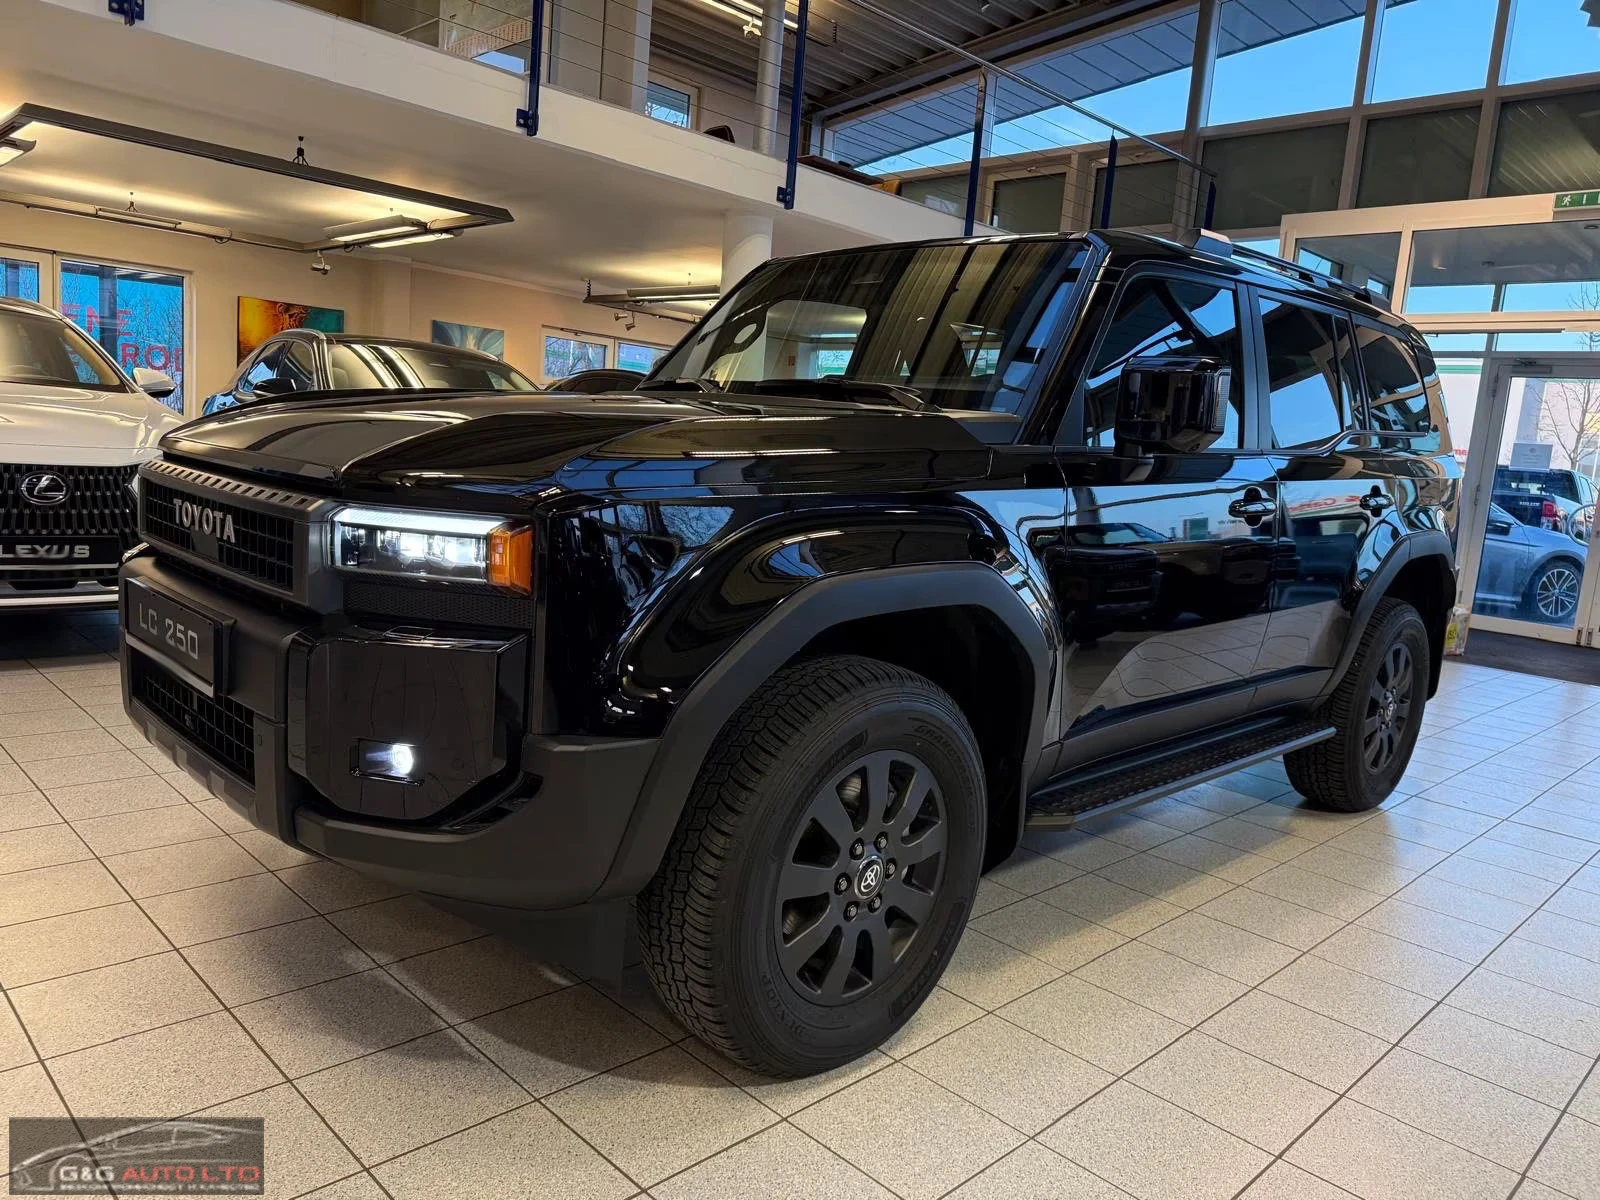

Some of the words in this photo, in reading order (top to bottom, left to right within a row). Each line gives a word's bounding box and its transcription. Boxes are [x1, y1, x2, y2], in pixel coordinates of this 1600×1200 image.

[173, 498, 235, 543] TOYOTA
[0, 544, 90, 559] LEXUS
[139, 603, 158, 635] LC
[165, 617, 199, 660] 250
